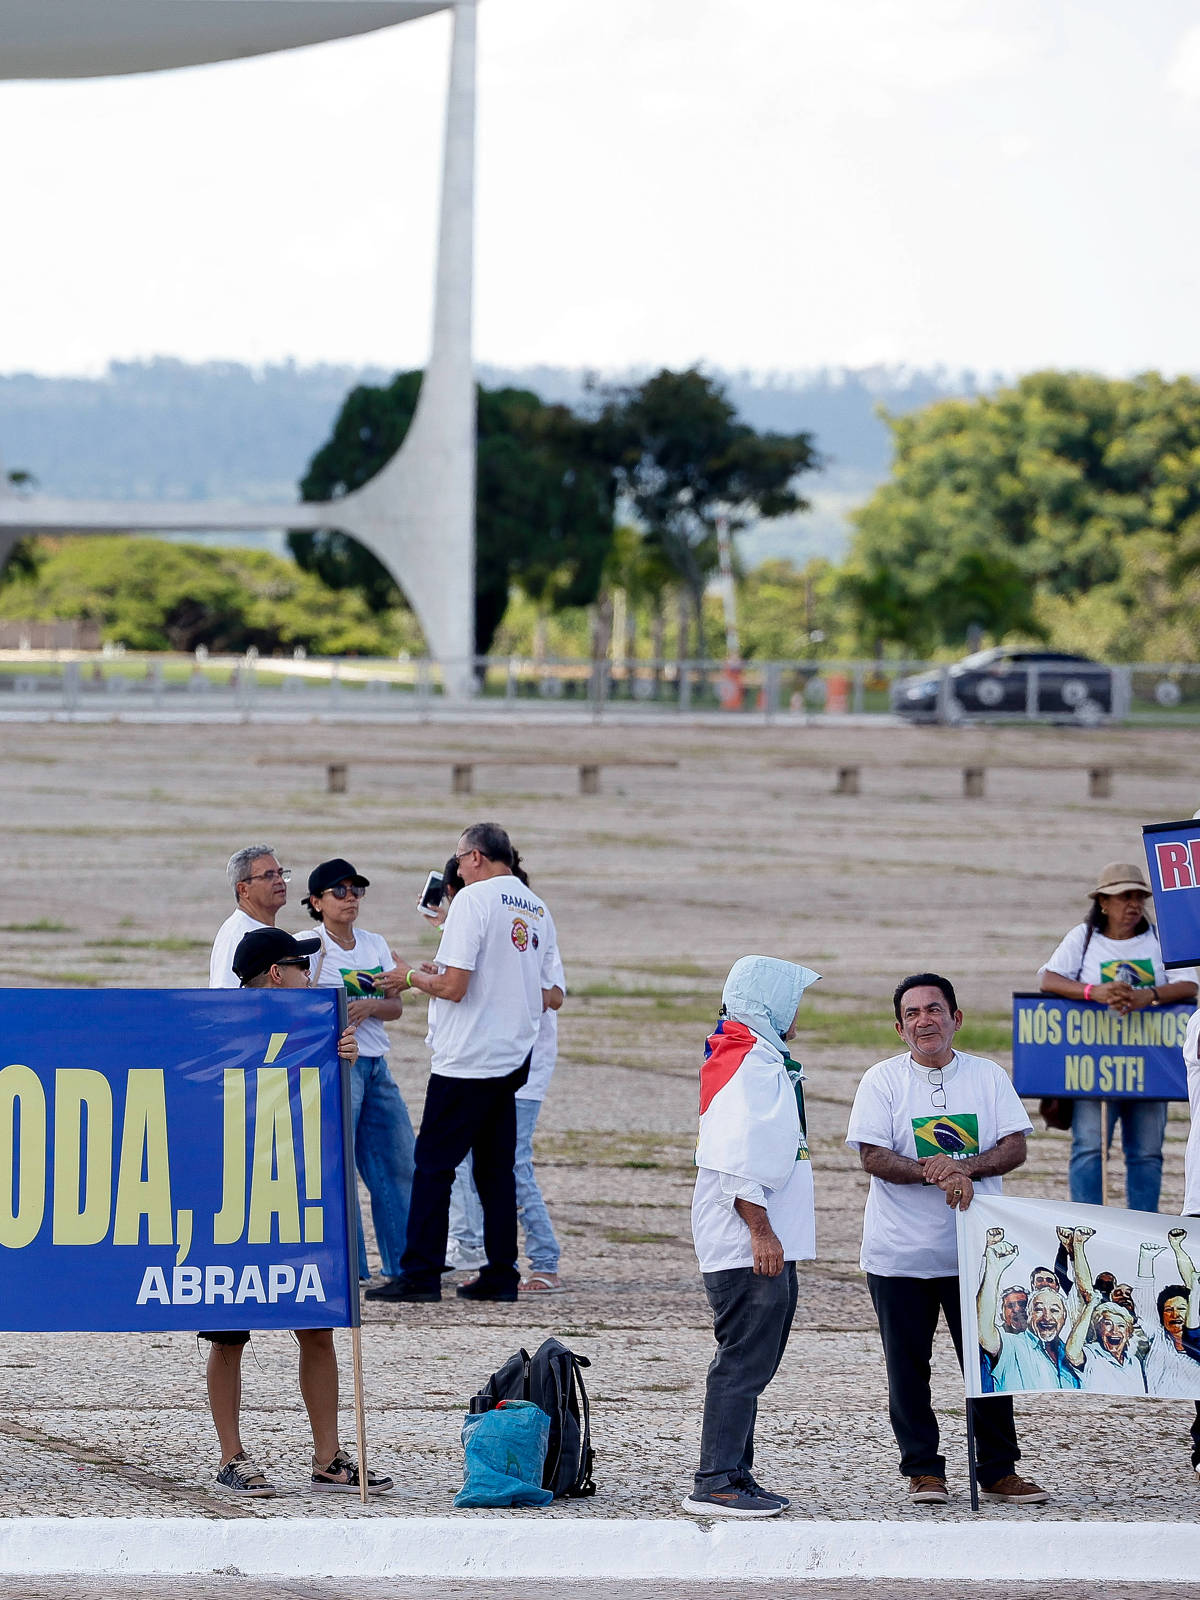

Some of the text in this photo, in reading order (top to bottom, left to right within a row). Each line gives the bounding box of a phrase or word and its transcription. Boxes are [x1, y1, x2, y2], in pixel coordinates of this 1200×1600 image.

[501, 895, 544, 917] RAMALHO
[1019, 1003, 1188, 1048] NÓS CONFIAMOS
[1065, 1055, 1144, 1092] NO STF!
[214, 1033, 324, 1244] JÁ!
[136, 1265, 326, 1305] ABRAPA
